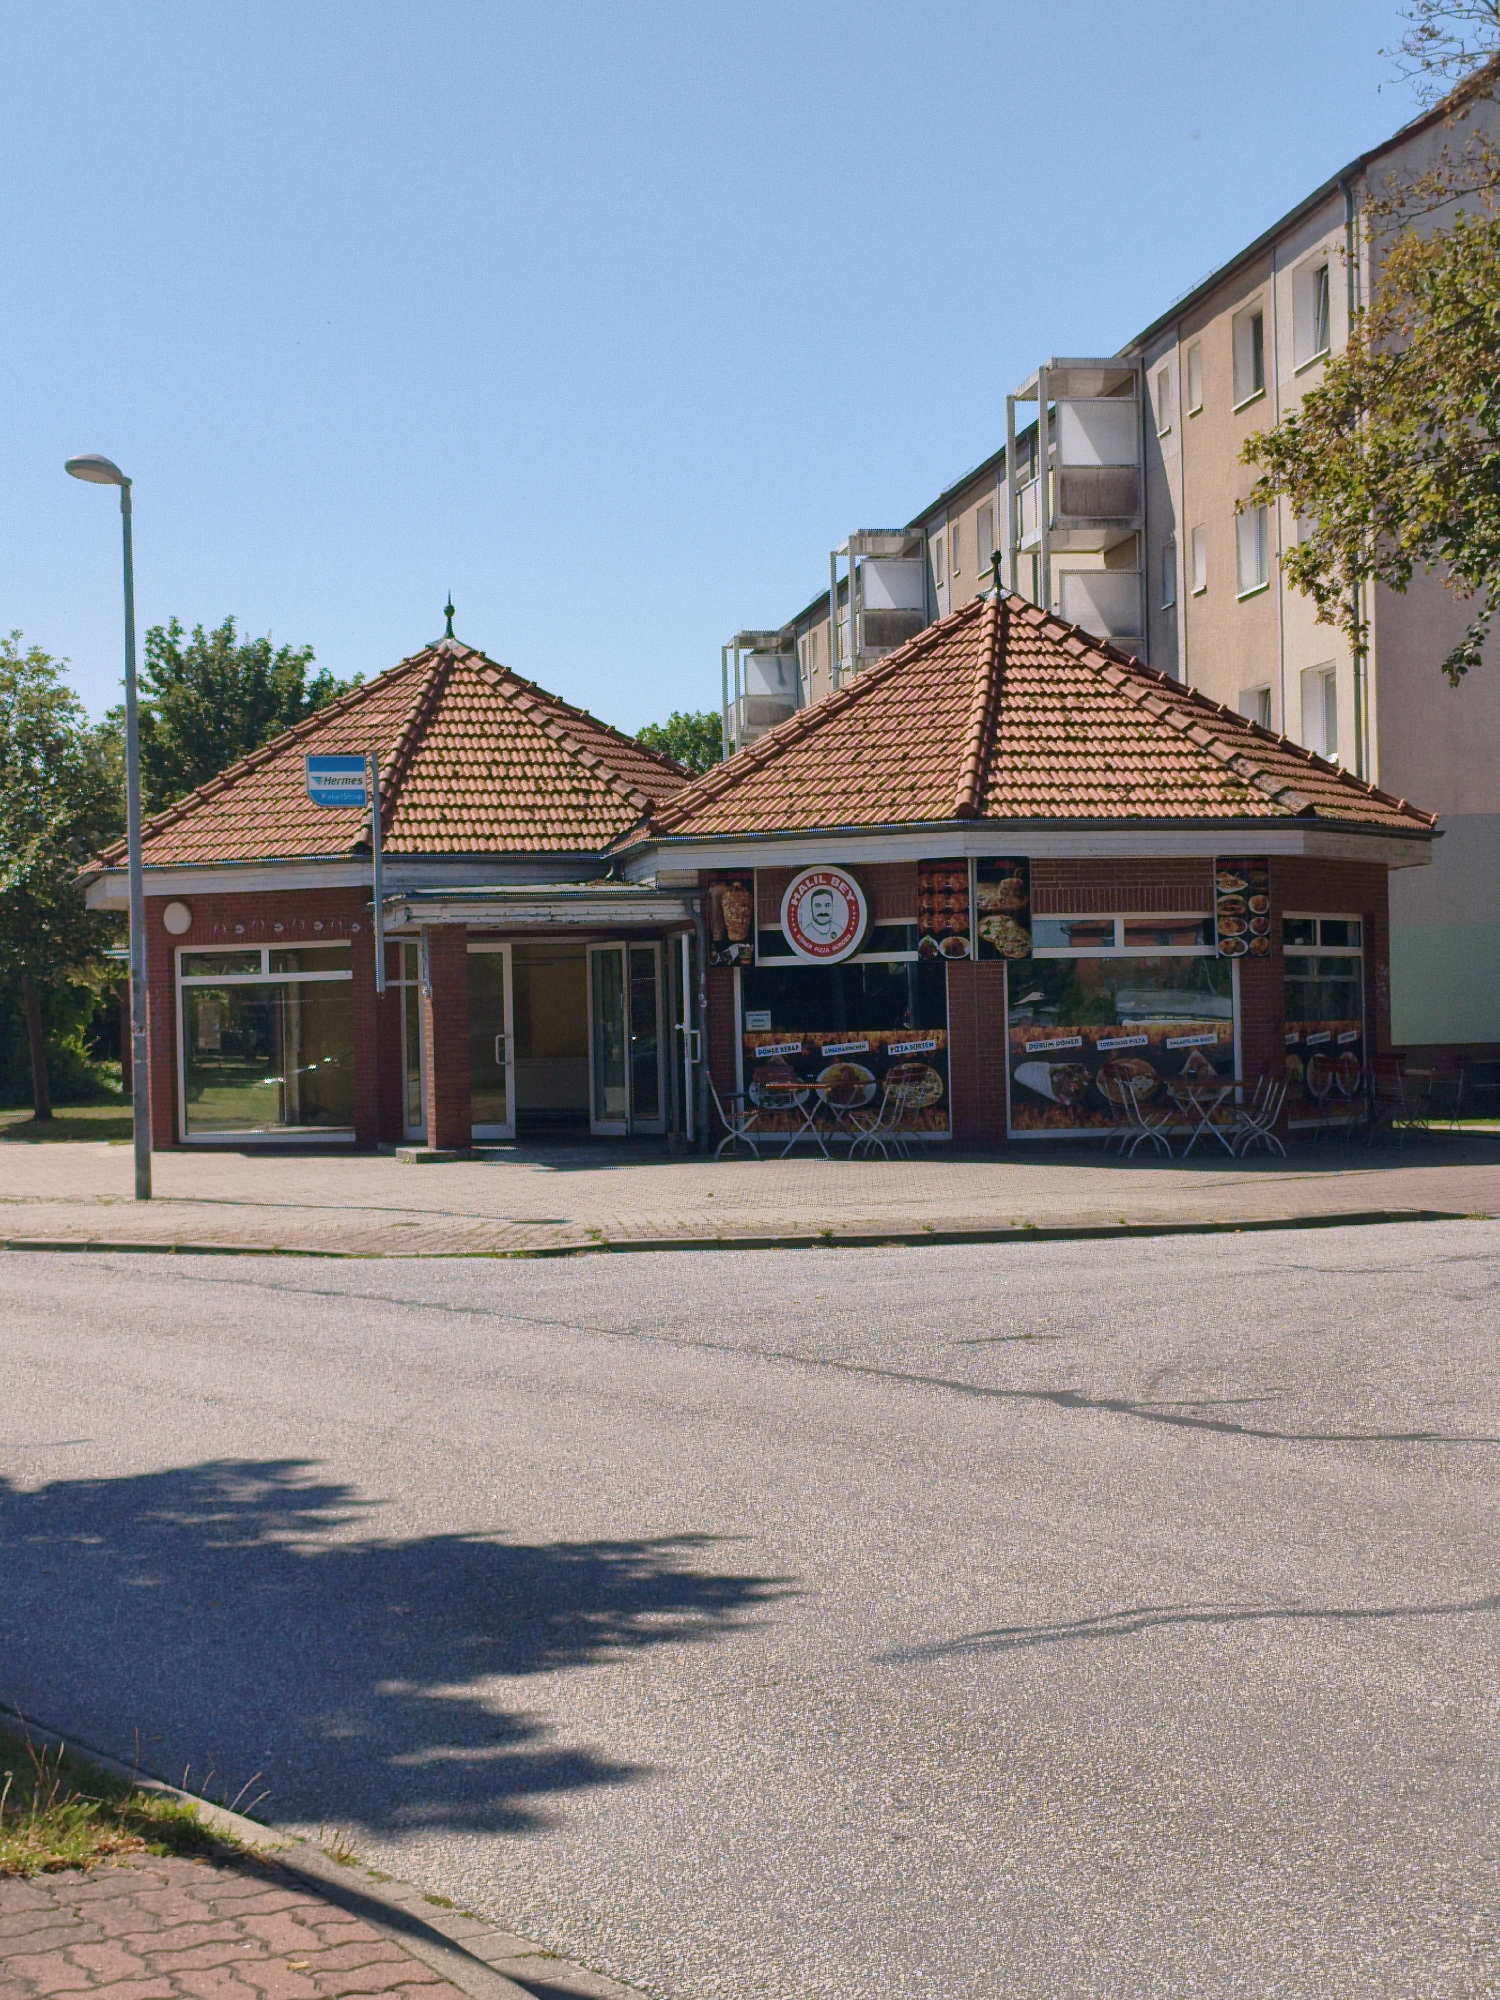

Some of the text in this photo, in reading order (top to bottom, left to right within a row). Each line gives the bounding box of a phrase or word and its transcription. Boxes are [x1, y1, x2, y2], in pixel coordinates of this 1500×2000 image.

[323, 776, 363, 786] Hermes
[790, 874, 856, 906] HALIL BEY
[890, 1044, 909, 1054] PIZZA
